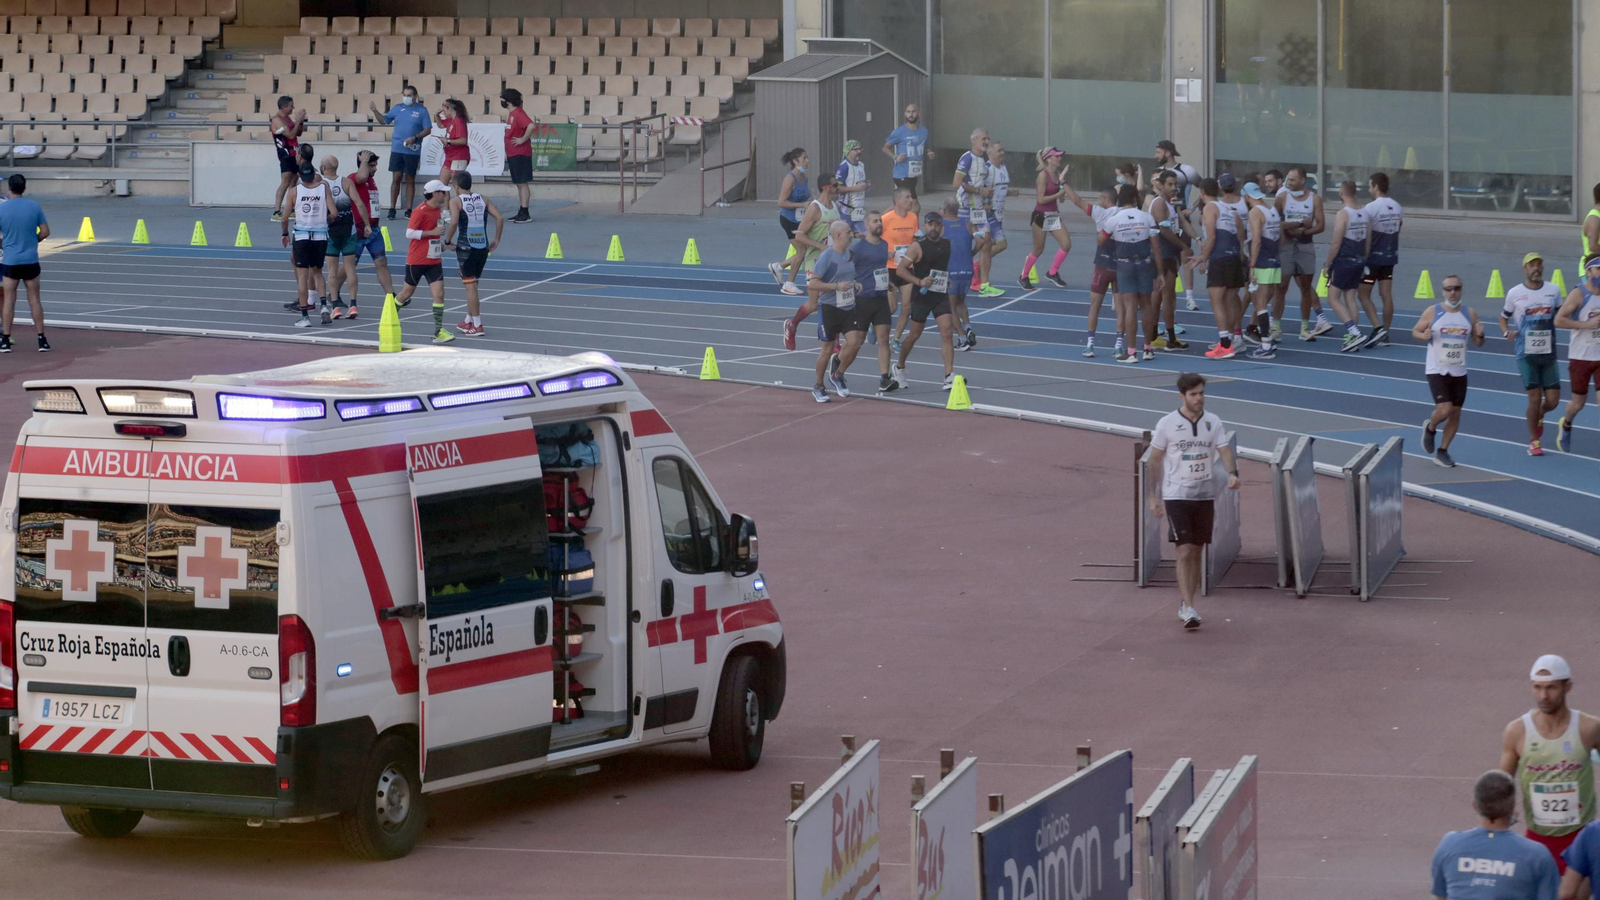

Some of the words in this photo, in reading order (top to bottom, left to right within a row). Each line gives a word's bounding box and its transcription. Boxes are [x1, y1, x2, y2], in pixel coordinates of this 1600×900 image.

[62, 449, 239, 482] AMBULANCIA
[1189, 462, 1206, 473] 123
[20, 631, 54, 652] Cruz
[58, 633, 91, 660] Roja
[95, 635, 161, 662] Española
[429, 615, 494, 663] Española
[219, 644, 269, 658] A-0.6-CA
[54, 701, 89, 718] 1957
[92, 703, 121, 720] LCZ
[1541, 799, 1569, 812] 922
[1457, 857, 1516, 877] DBM
